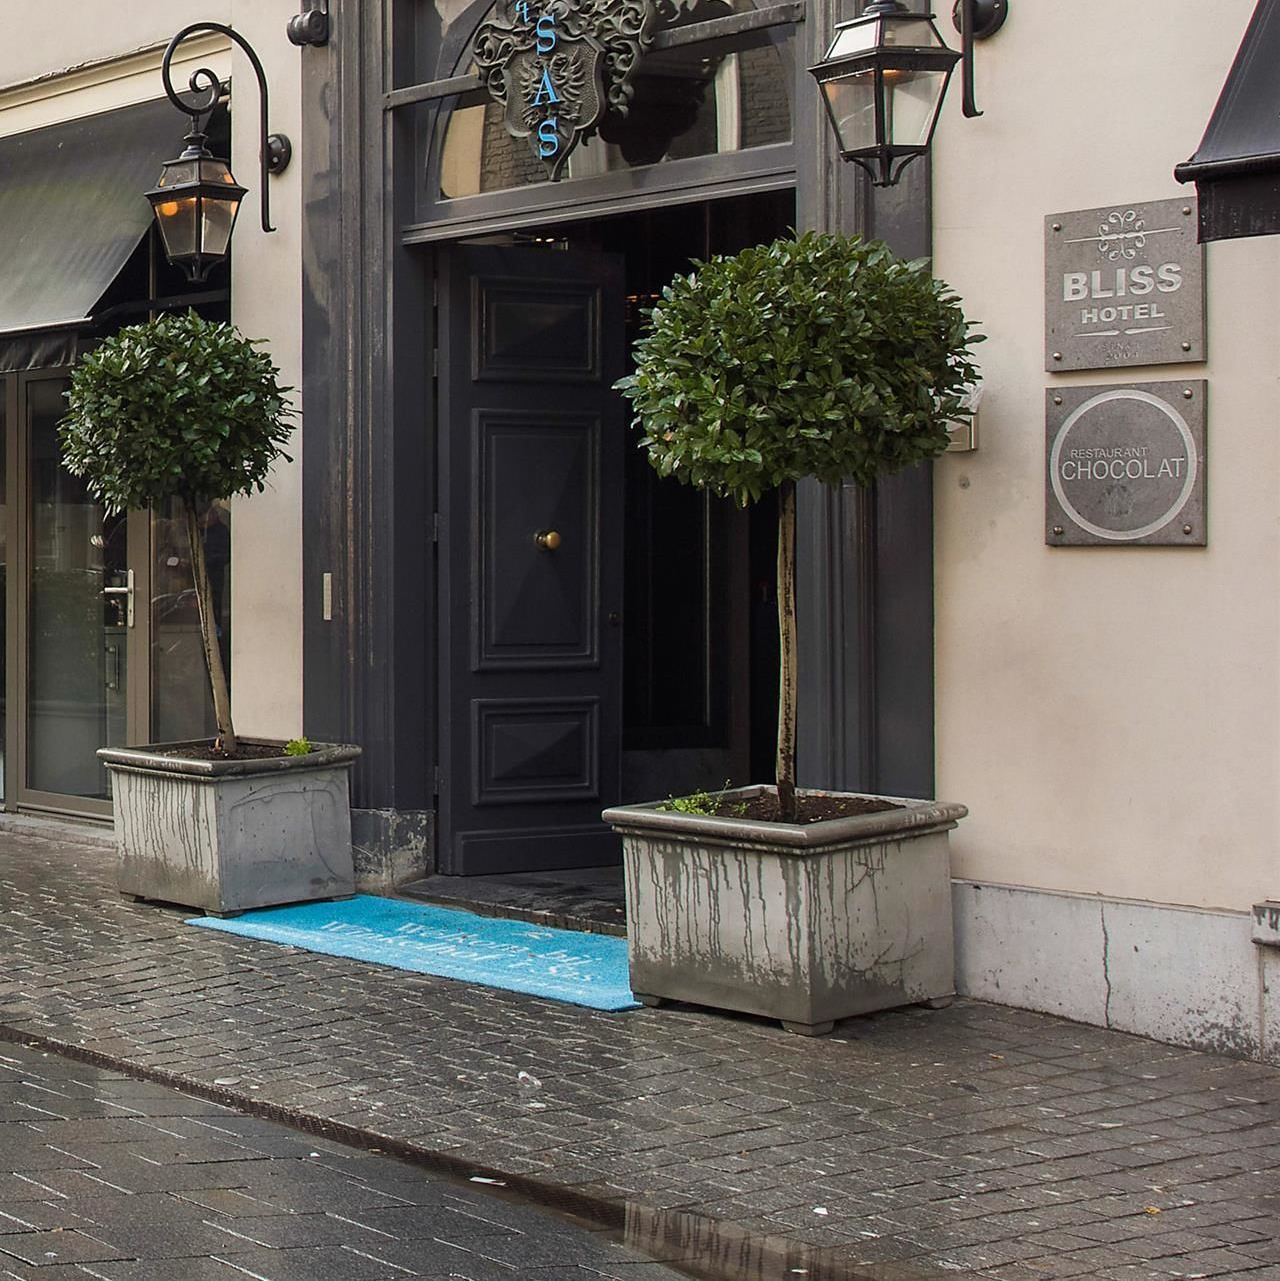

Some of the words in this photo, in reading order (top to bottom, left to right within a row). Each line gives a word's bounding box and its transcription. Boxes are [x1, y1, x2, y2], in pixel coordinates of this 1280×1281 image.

[1063, 262, 1183, 302] BLISS
[1081, 303, 1165, 324] HOTEL
[1070, 447, 1149, 459] RESTAURANT
[1061, 458, 1185, 480] CHOCOLAT
